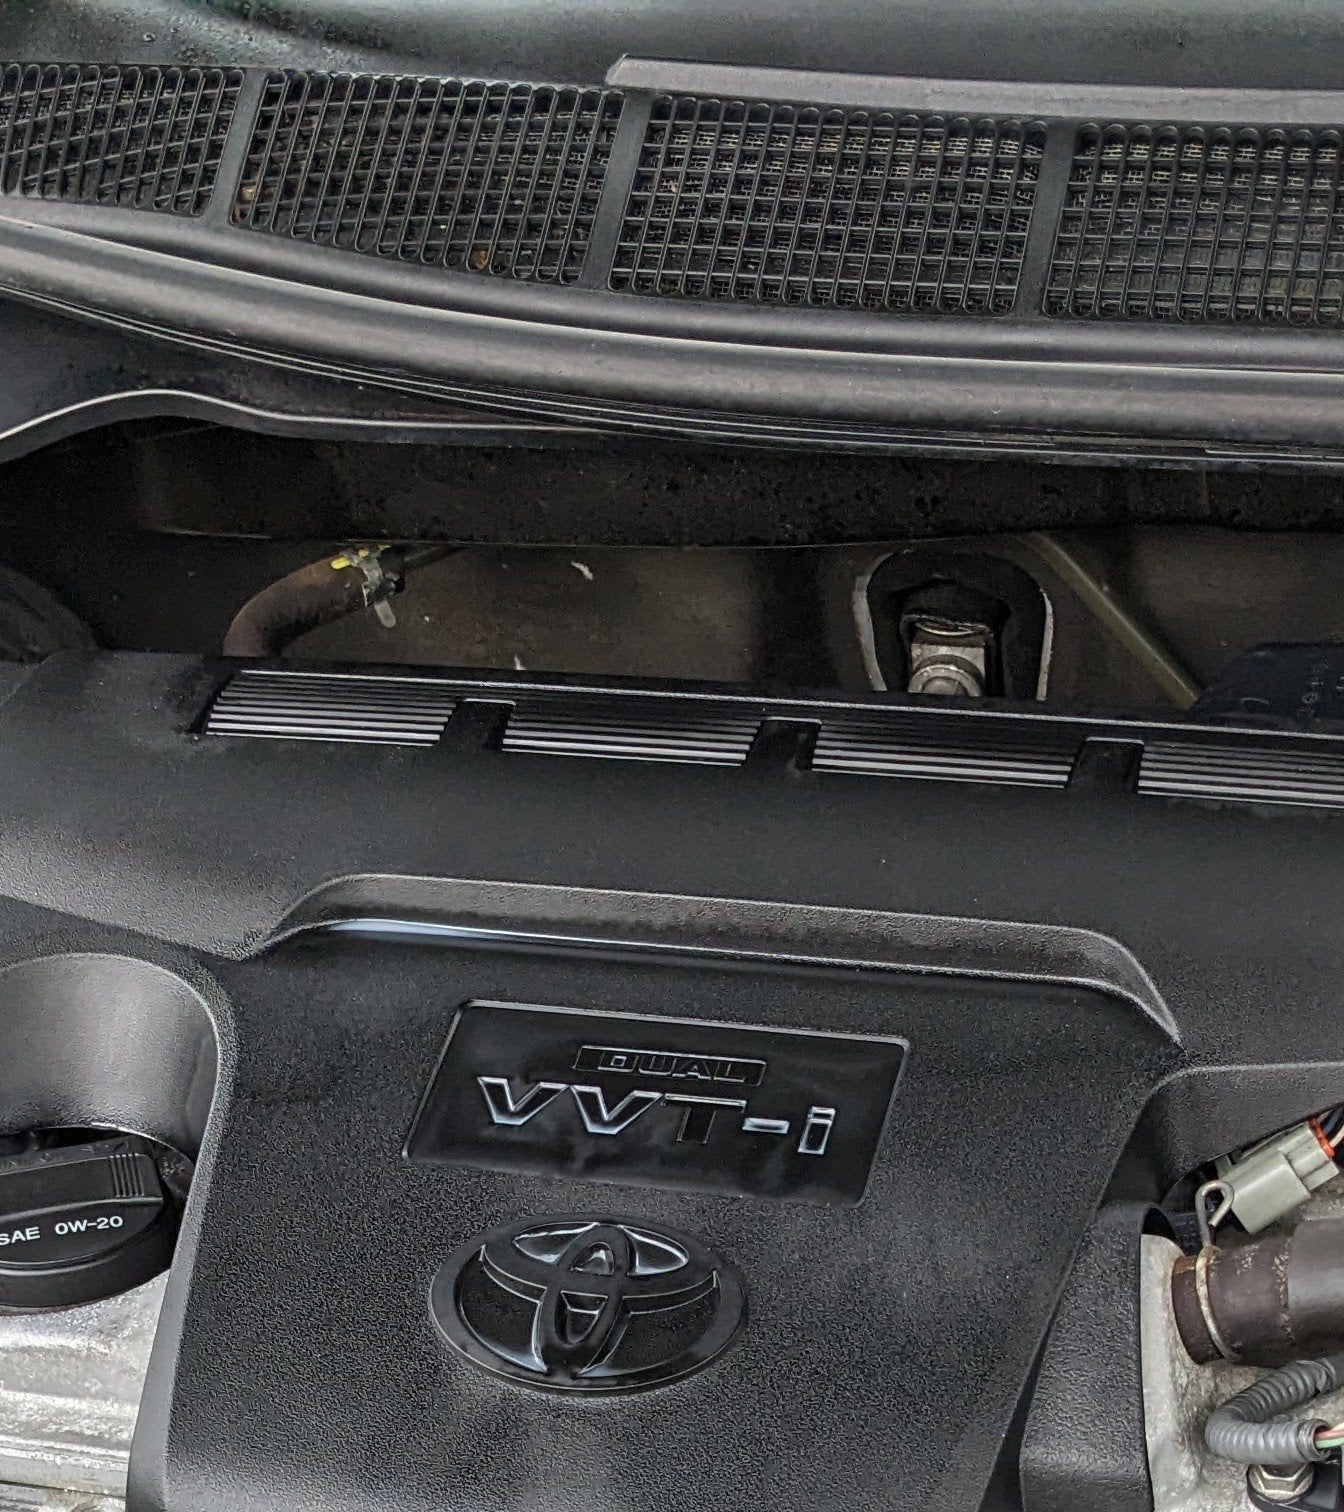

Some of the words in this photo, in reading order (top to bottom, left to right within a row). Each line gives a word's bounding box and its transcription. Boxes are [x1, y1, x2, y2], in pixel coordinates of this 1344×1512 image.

[596, 1050, 748, 1083] DUAL
[476, 1075, 838, 1156] VVT-i
[54, 1215, 124, 1236] 0W-20
